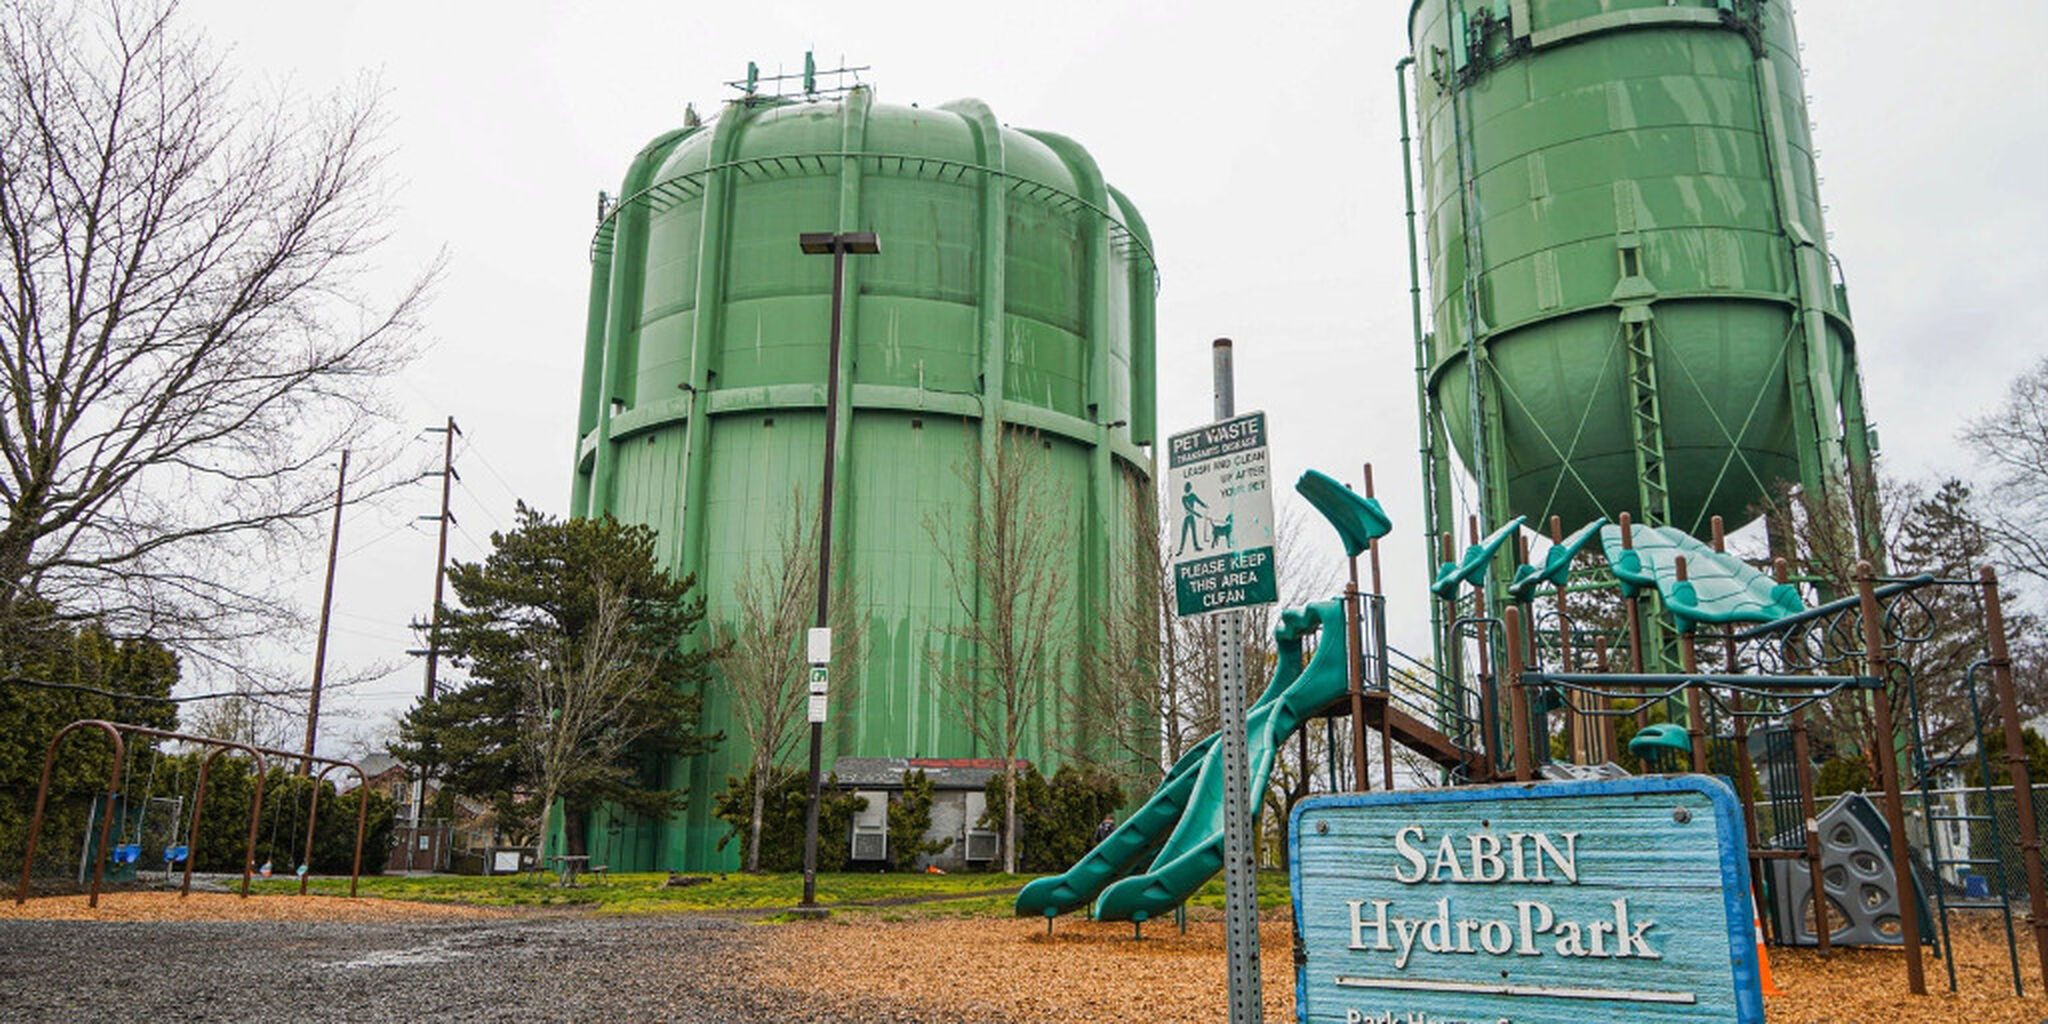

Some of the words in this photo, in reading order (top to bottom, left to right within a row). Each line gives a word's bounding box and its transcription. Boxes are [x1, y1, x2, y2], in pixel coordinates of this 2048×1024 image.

[1174, 434, 1200, 452] PET
[1206, 419, 1258, 443] WASTE
[1234, 451, 1264, 465] CLEAN
[1236, 465, 1265, 480] AFTER
[1181, 558, 1226, 579] PLEASE
[1230, 552, 1267, 570] KEEP
[1189, 577, 1217, 593] THIS
[1221, 571, 1258, 588] AREA
[1202, 589, 1246, 607] CLEAN
[1393, 824, 1581, 885] SABIN
[1345, 896, 1663, 970] HydroPark
